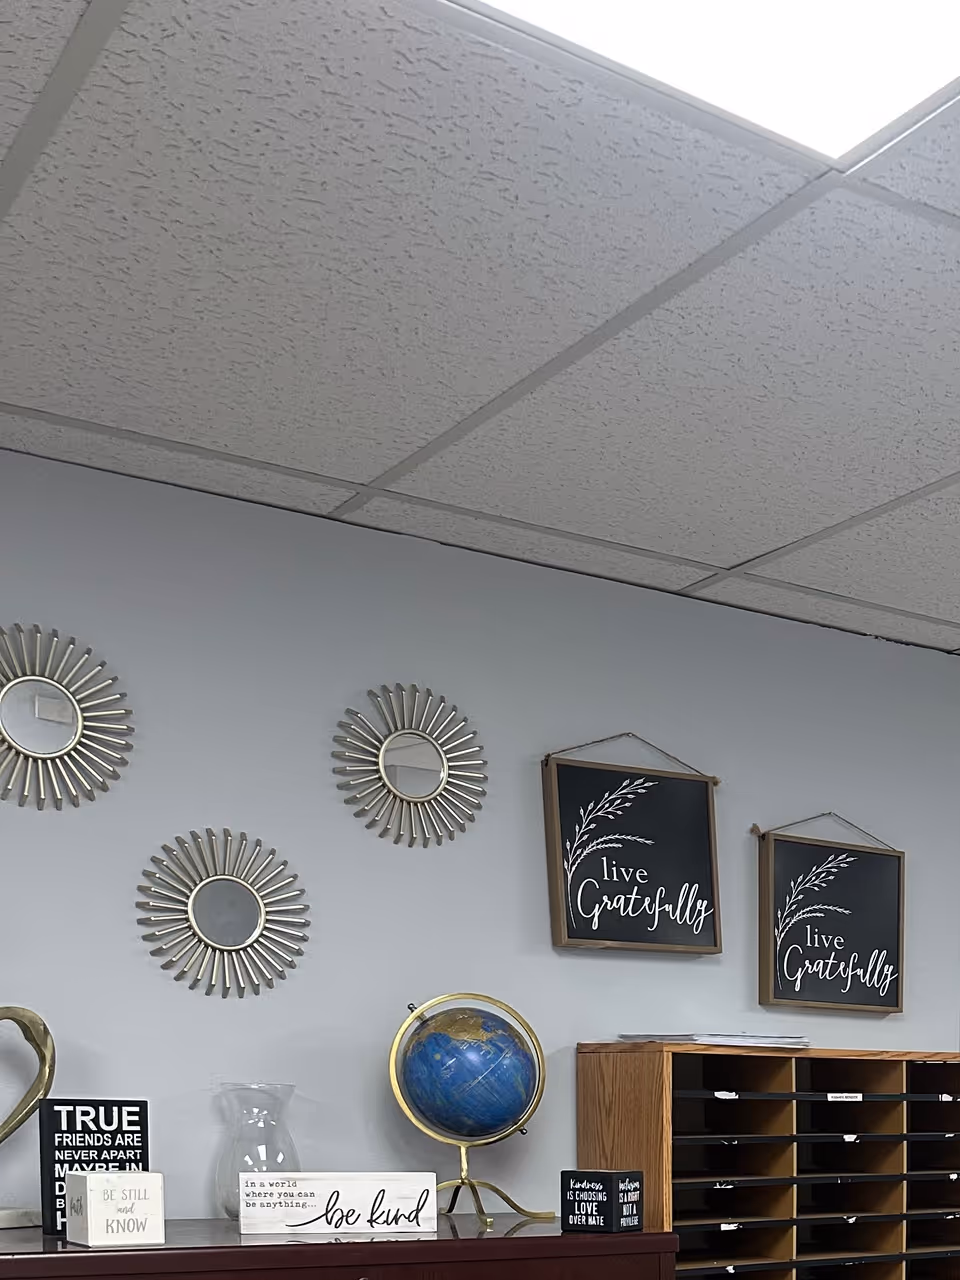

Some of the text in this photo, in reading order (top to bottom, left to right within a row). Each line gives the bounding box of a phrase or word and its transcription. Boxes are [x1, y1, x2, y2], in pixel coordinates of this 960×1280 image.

[602, 857, 649, 884] live
[577, 878, 714, 934] Gratefully
[806, 924, 845, 950] live
[783, 944, 899, 997] Gratefully
[54, 1105, 141, 1131] TRUE
[54, 1133, 142, 1146] FRIENDS ARE
[55, 1150, 142, 1160] NEVER APART
[245, 1180, 256, 1188] in
[268, 1180, 298, 1188] world
[570, 1178, 603, 1191] Kindness
[103, 1188, 150, 1201] BE STILL
[245, 1190, 275, 1199] where
[277, 1191, 295, 1200] you
[567, 1191, 607, 1201] IS CHOOSING
[117, 1202, 135, 1214] and
[245, 1200, 257, 1208] be
[285, 1188, 430, 1229] be kind
[575, 1202, 598, 1215] LOVE
[105, 1218, 148, 1234] KNOW
[569, 1215, 604, 1226] OVER HATE
